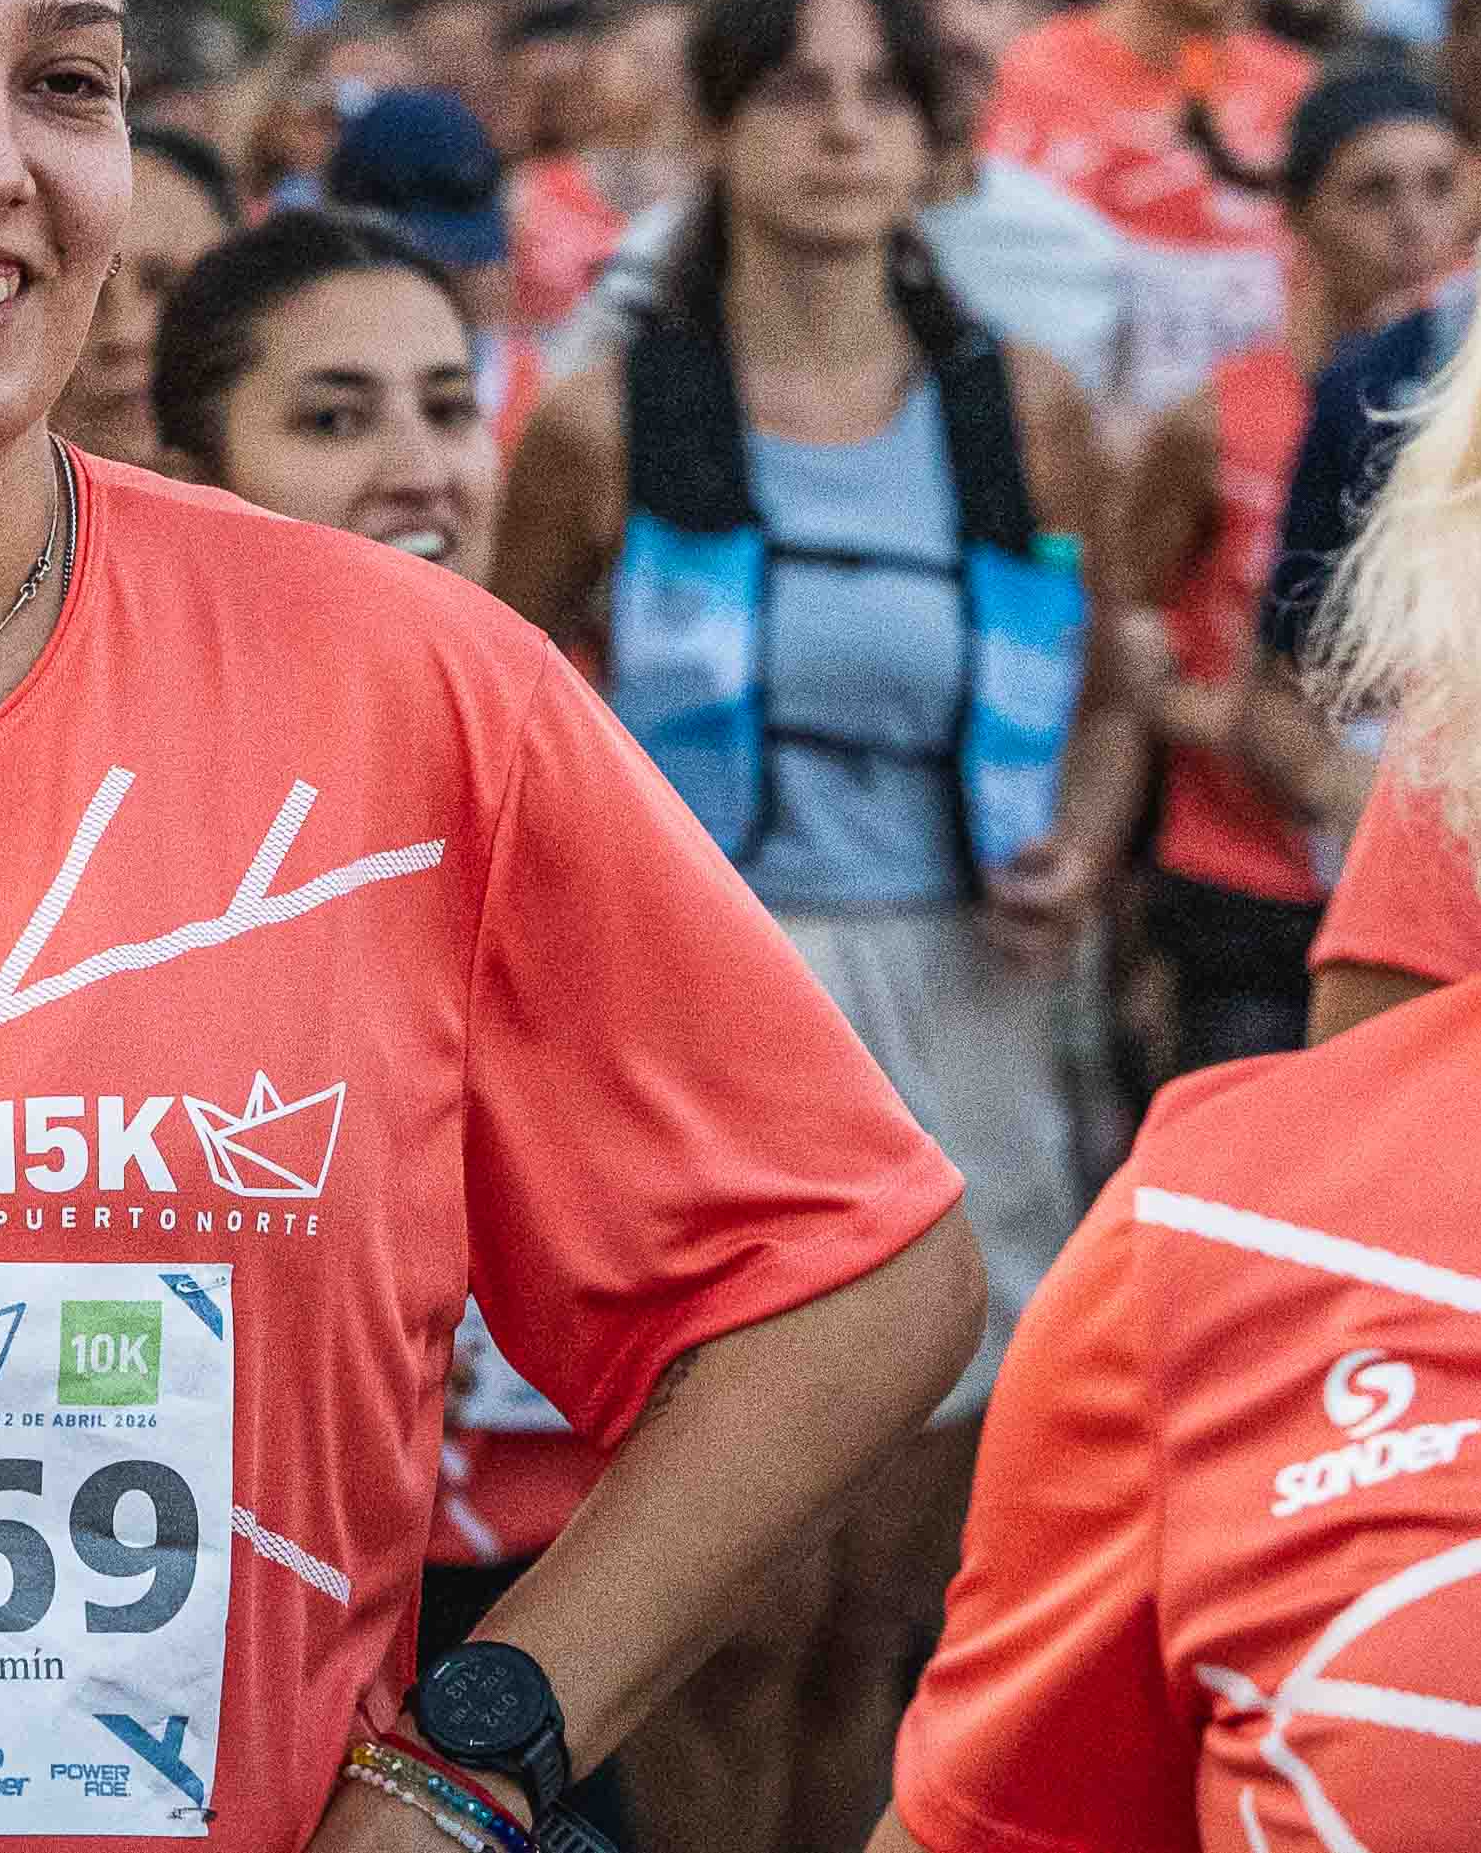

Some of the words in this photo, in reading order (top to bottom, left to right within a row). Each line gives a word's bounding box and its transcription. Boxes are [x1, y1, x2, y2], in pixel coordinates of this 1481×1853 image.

[71, 1331, 150, 1376] 10K
[21, 1412, 45, 1427] DE
[52, 1412, 107, 1428] ABRIL
[115, 1413, 158, 1428] 2026
[50, 1763, 130, 1780] POWER
